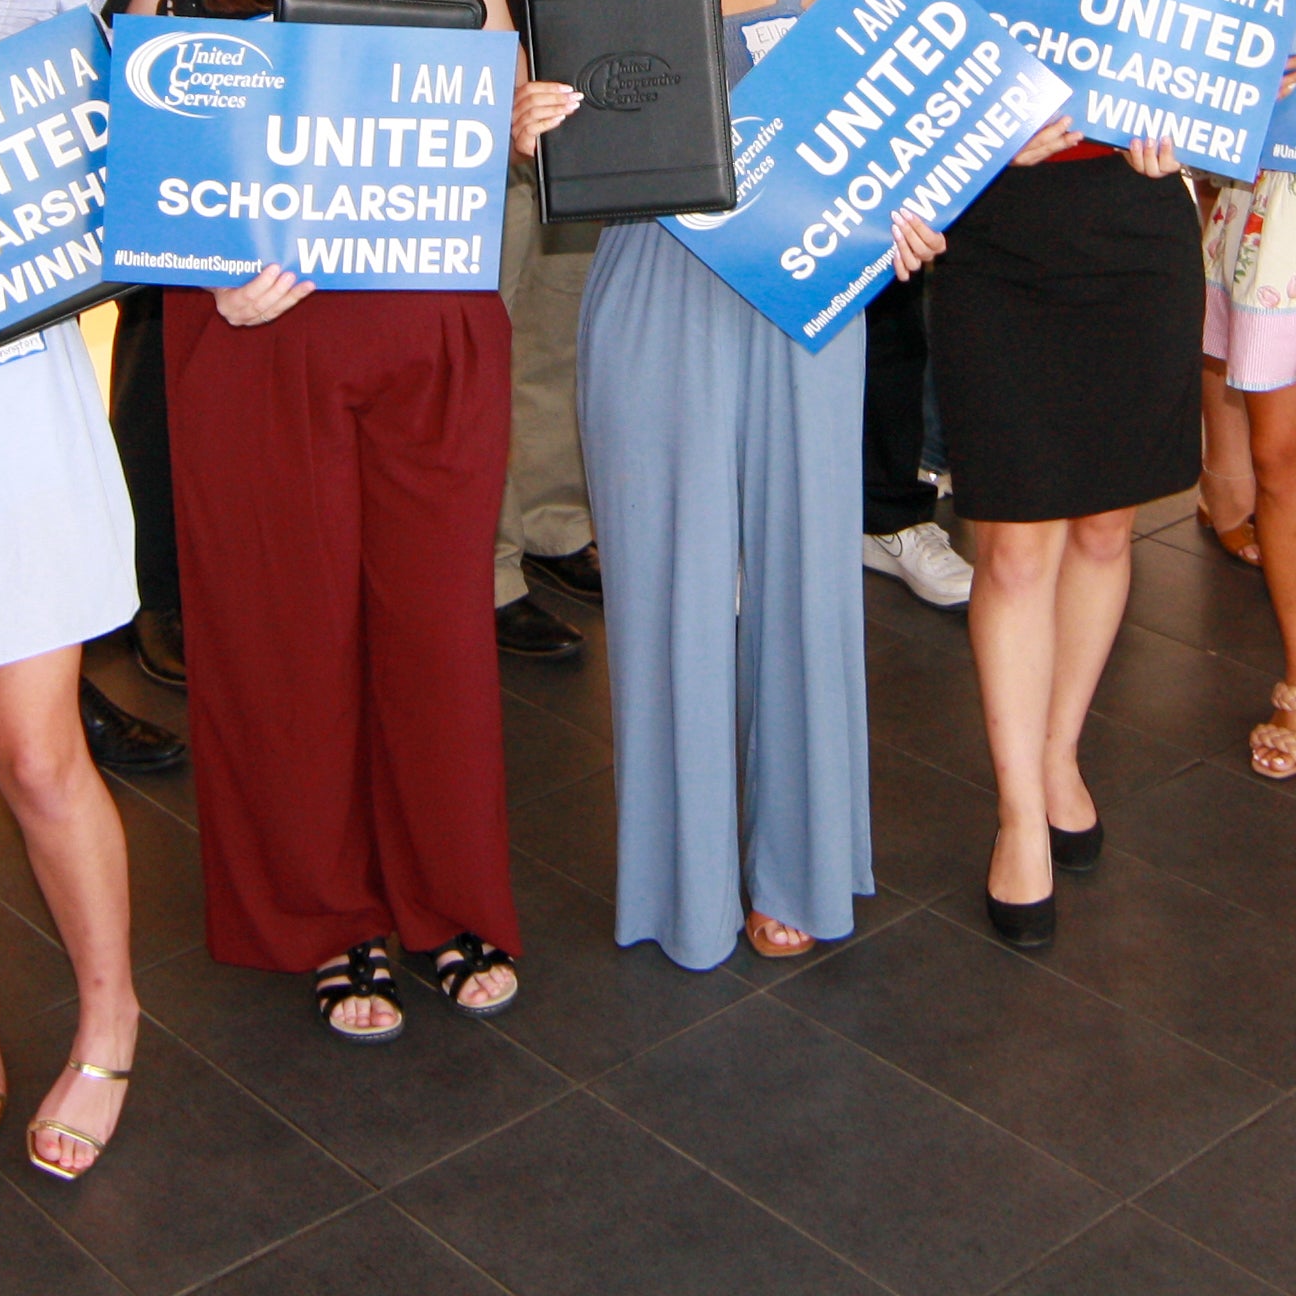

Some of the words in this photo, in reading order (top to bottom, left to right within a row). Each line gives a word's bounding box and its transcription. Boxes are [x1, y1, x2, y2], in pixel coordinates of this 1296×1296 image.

[176, 42, 245, 70] United
[836, 26, 864, 55] I
[10, 60, 65, 115] AM
[70, 48, 98, 87] A
[165, 84, 246, 108] Services
[171, 66, 285, 90] Cooperative
[391, 63, 401, 102] I
[411, 64, 462, 104] AM
[473, 65, 495, 105] A
[795, 0, 967, 177] UNITED
[266, 115, 494, 168] UNITED
[1086, 89, 1248, 164] WINNER!
[736, 155, 775, 202] ervices
[779, 40, 1002, 281] SCHOLARSHIP
[157, 178, 487, 221] SCHOLARSHIP
[115, 250, 263, 274] #UnitedStudentSupport
[297, 235, 482, 274] WINNER!
